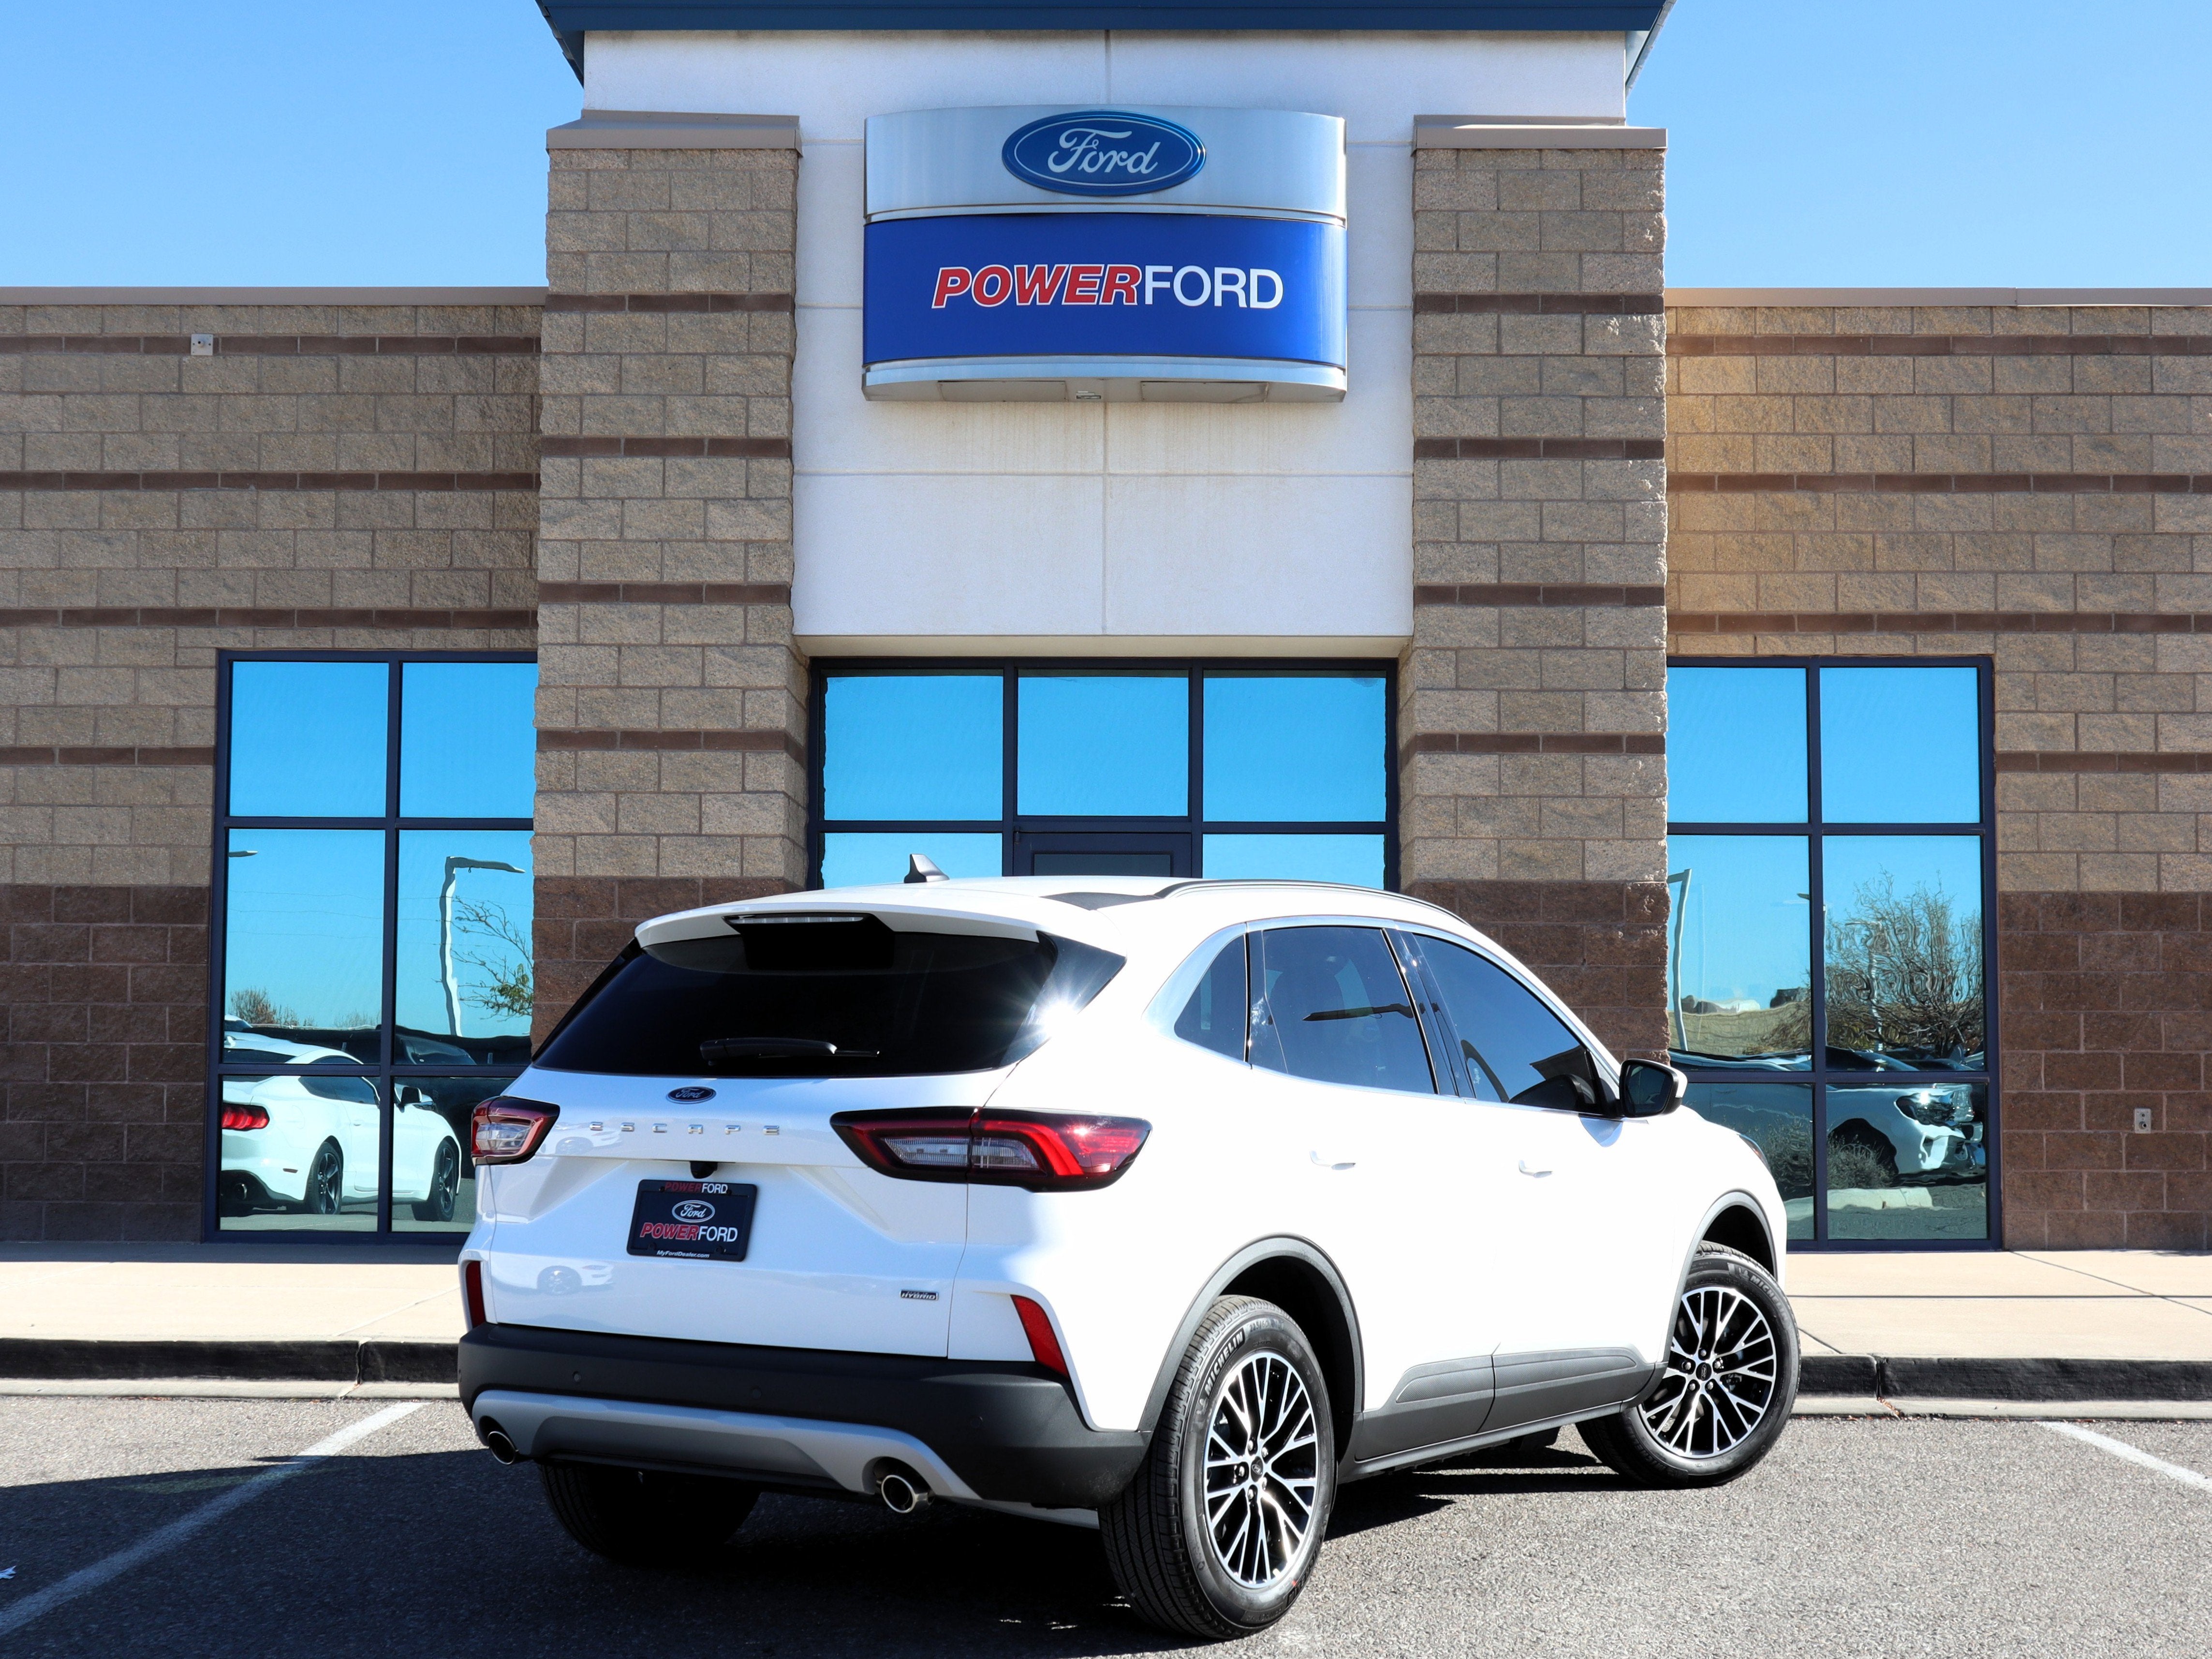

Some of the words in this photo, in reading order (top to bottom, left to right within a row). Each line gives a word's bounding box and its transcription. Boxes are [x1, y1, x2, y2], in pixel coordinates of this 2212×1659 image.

[1047, 128, 1161, 175] Ford
[676, 1087, 705, 1098] Ford
[589, 1121, 780, 1135] ESCAPE
[680, 1203, 707, 1218] Ford
[656, 1249, 710, 1258] MyFordDealer.com
[1750, 1275, 1788, 1321] MICHELIN
[1204, 1330, 1244, 1395] MICHELIN
